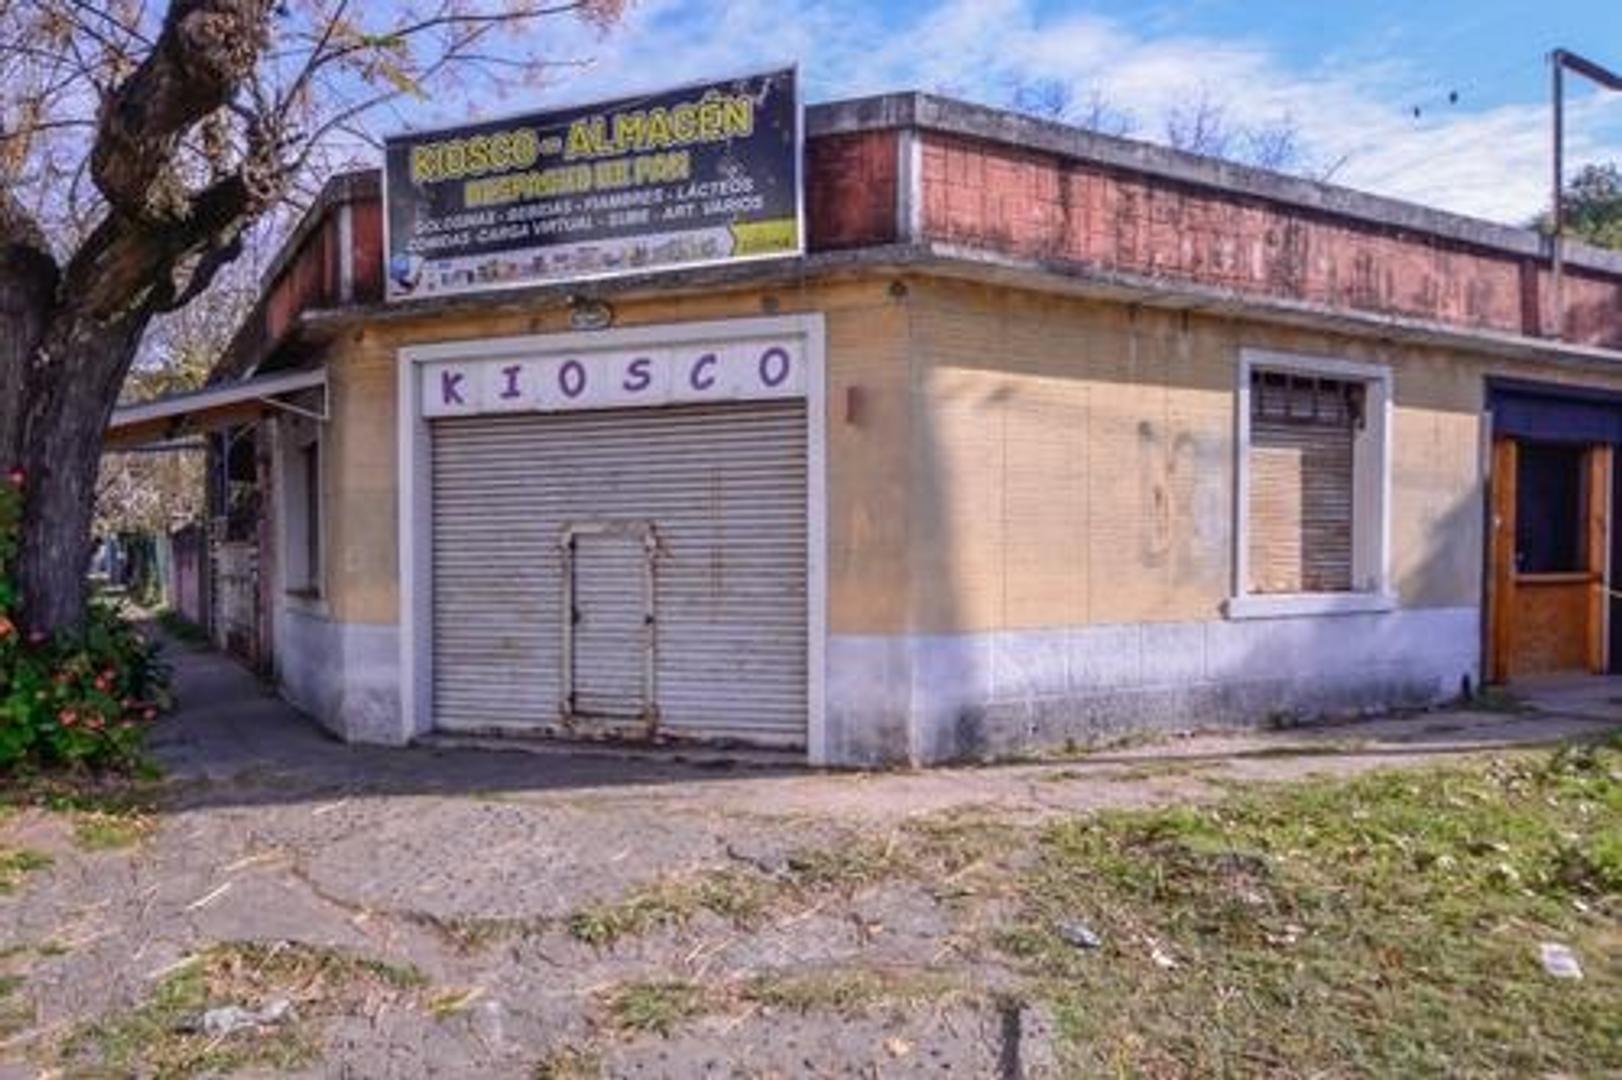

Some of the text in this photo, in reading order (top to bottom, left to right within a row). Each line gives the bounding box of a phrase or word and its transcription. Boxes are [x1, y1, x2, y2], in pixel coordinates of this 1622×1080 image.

[410, 127, 539, 182] KIOSCO
[564, 89, 755, 161] ALMACÉN
[441, 347, 790, 404] KIOSCO
